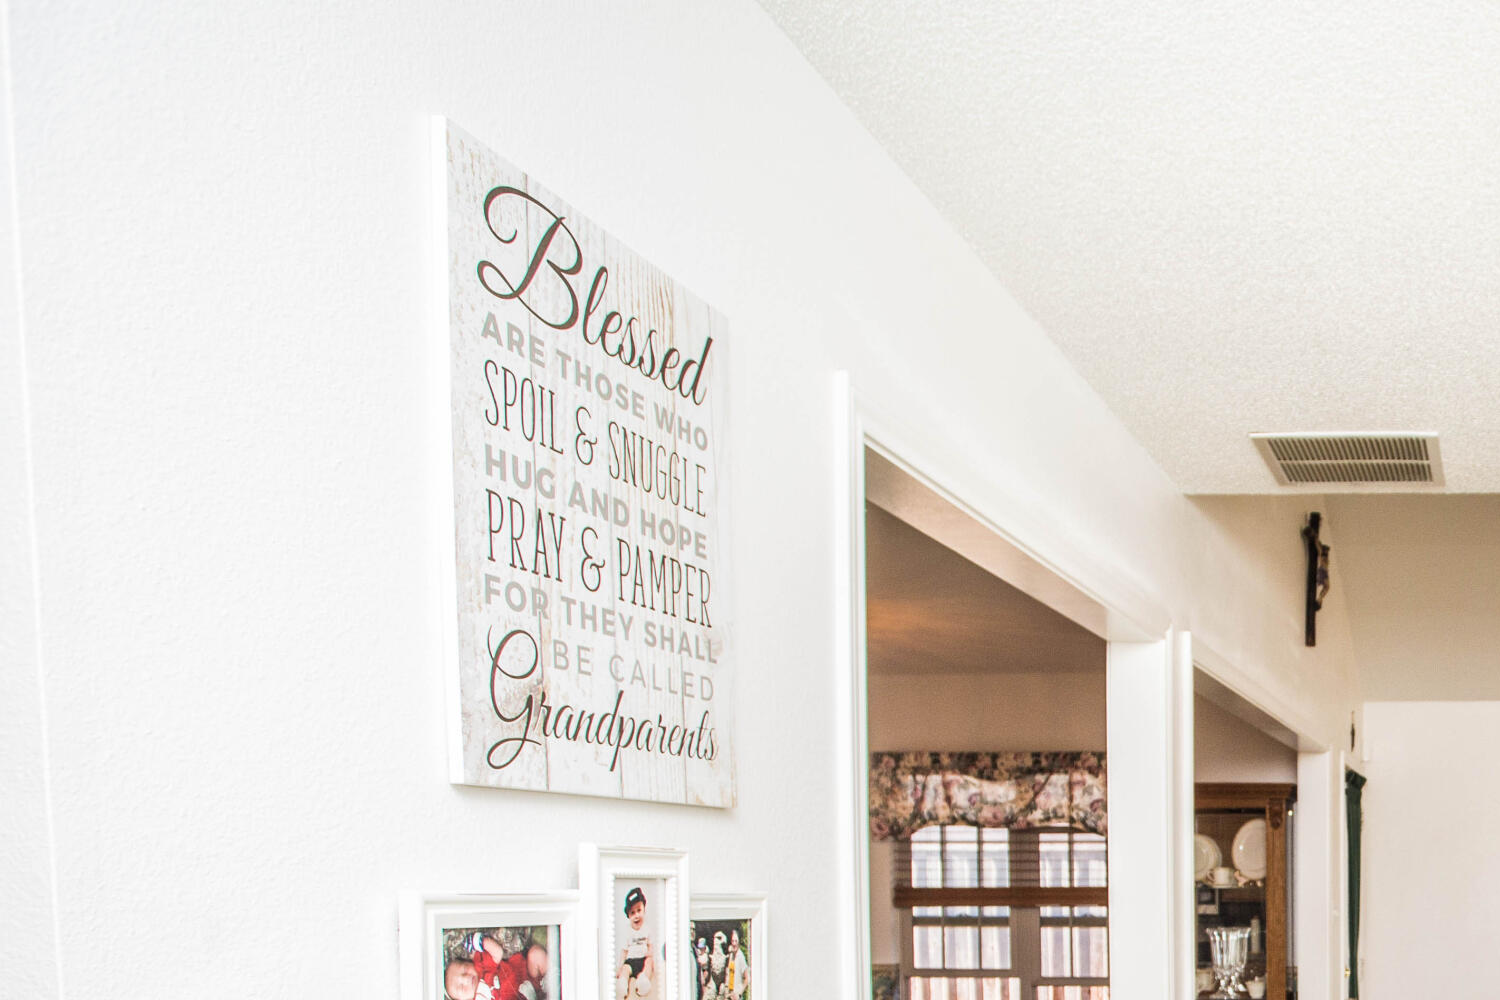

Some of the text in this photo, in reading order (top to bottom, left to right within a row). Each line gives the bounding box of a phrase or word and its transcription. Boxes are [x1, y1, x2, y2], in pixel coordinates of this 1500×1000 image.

[477, 185, 713, 405] Blessed
[481, 311, 708, 451] ARE THOSE WHO
[484, 359, 707, 518] SPOIL & SNUGGLE
[485, 443, 708, 560] HUG AND HOPE
[485, 488, 712, 628] PRAY & PAMPER
[485, 573, 717, 664] FOR THEY SHALL
[553, 639, 714, 702] BE CALLED
[486, 624, 719, 772] Grandparents
